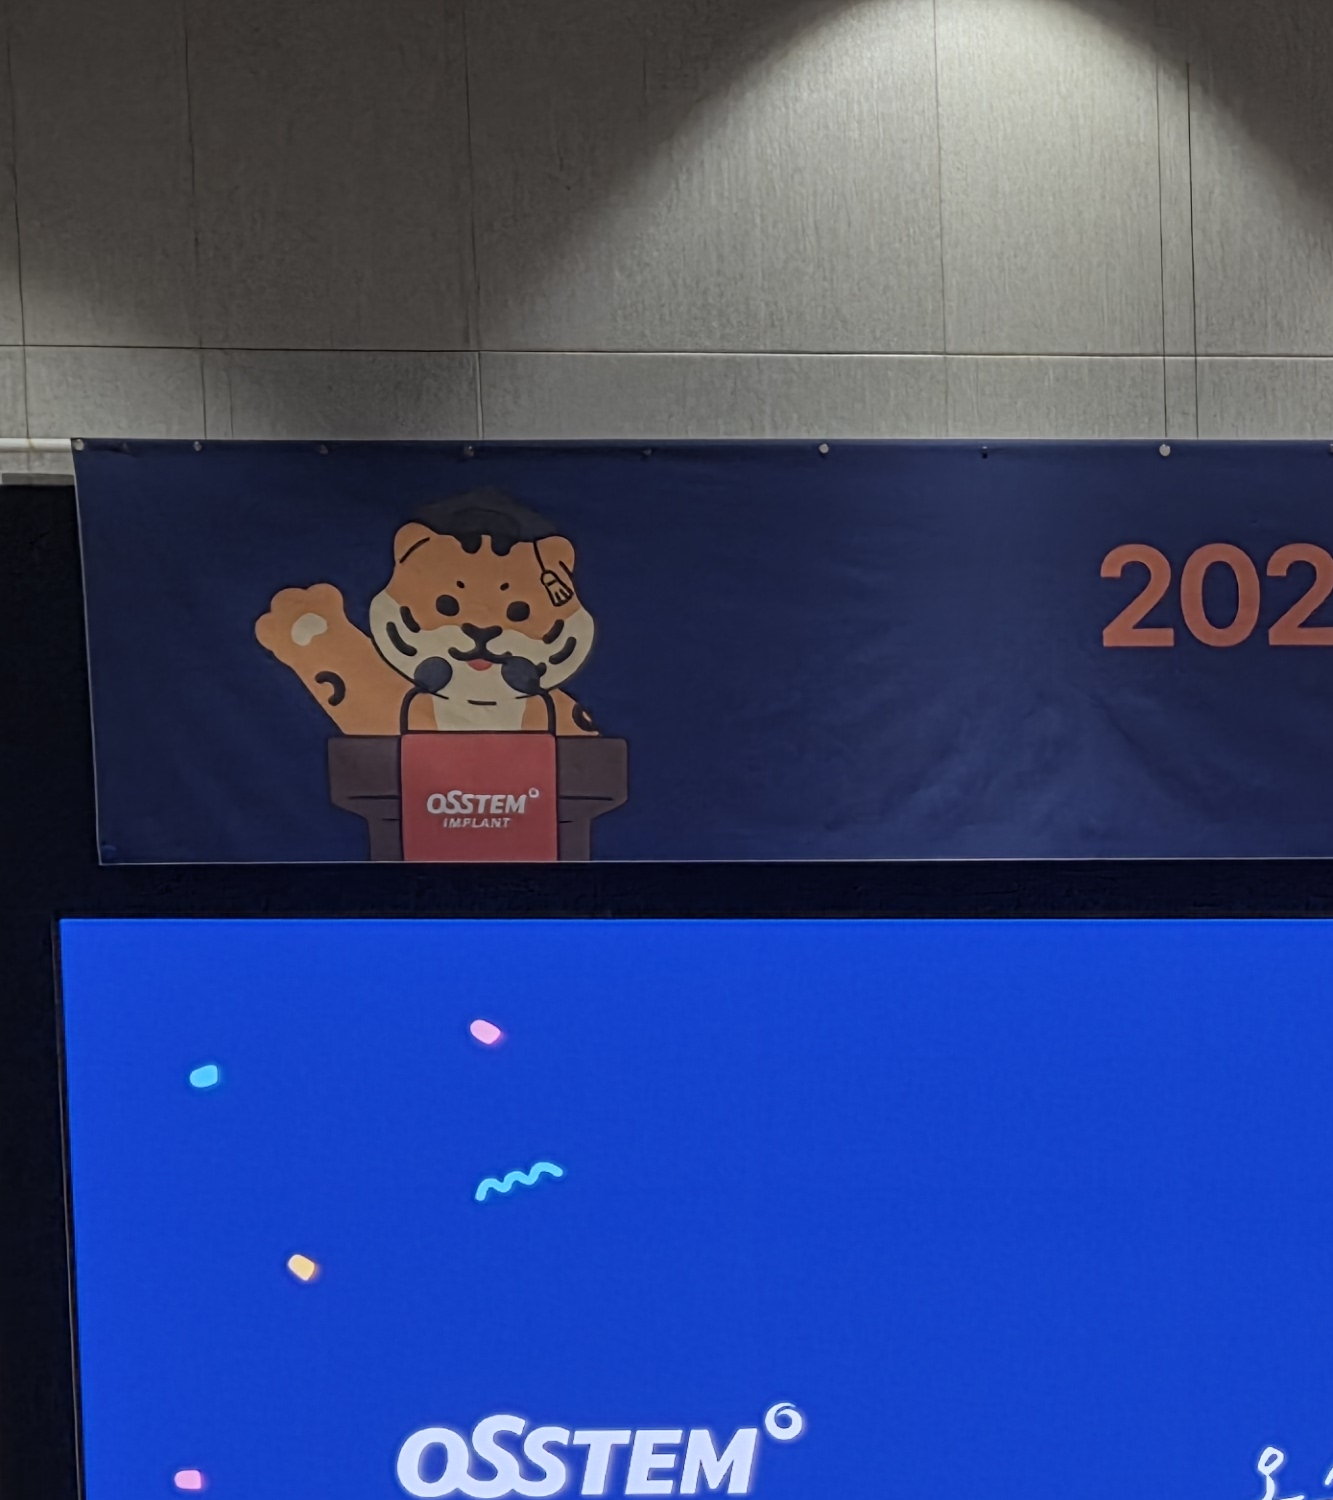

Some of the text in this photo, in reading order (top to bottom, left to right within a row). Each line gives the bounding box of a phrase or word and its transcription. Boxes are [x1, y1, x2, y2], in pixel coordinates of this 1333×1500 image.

[426, 789, 527, 815] OSSTEM
[442, 817, 512, 829] IMPLANT
[396, 1414, 759, 1499] OSSTEM
